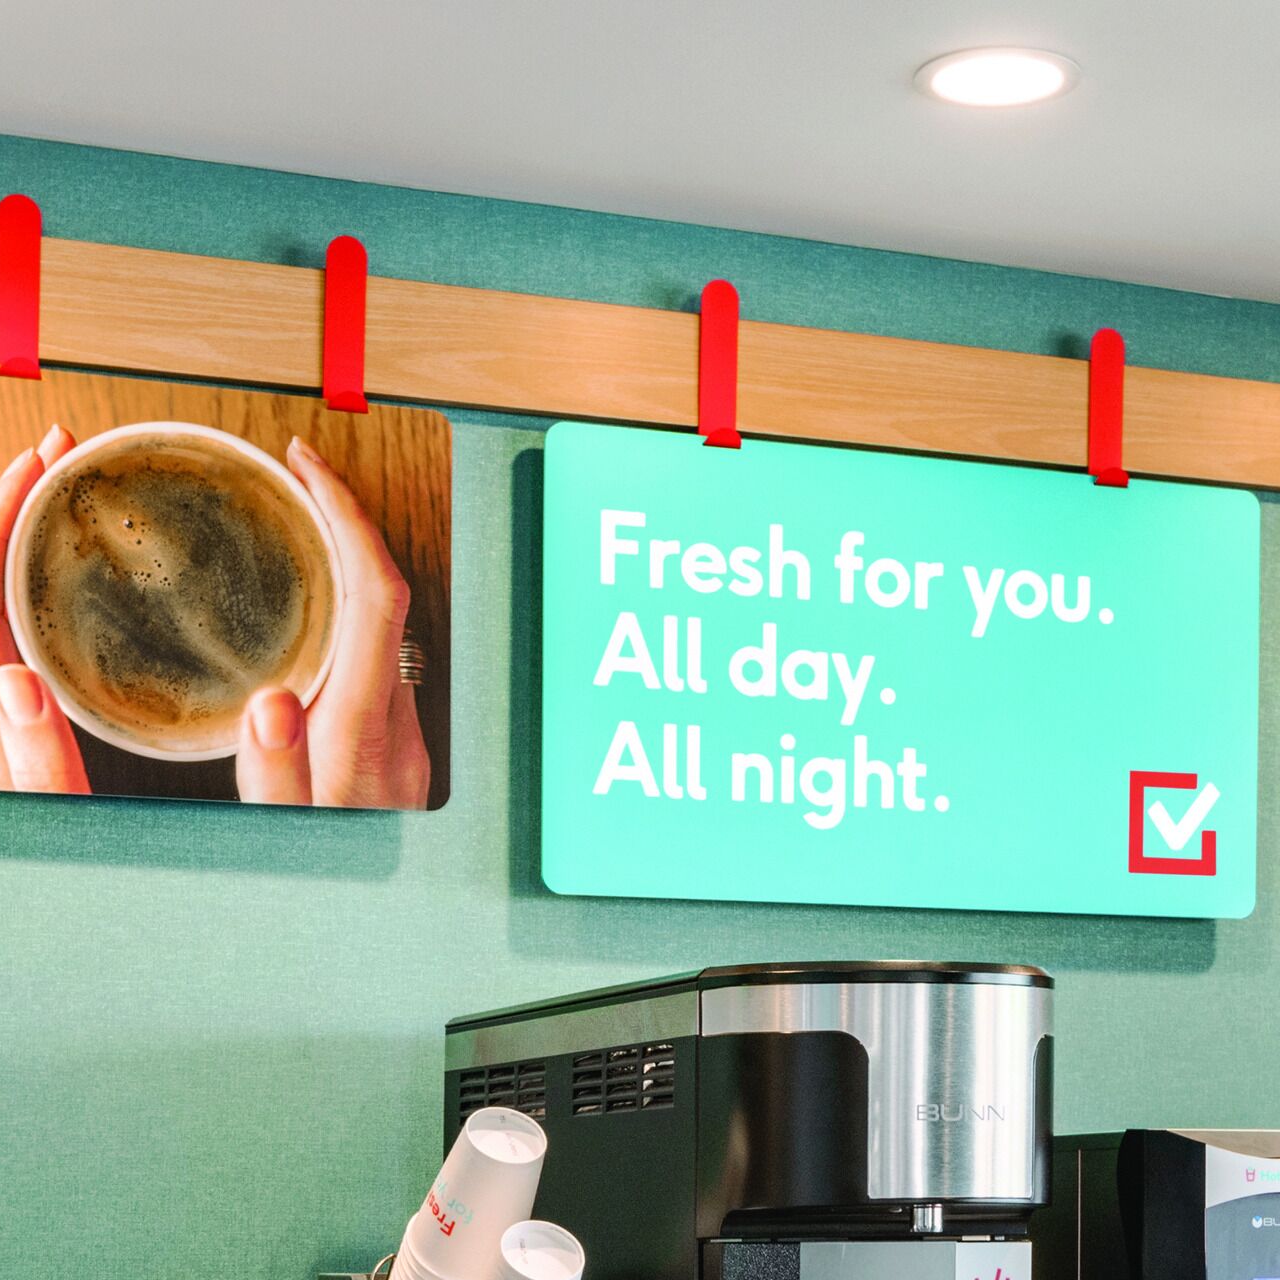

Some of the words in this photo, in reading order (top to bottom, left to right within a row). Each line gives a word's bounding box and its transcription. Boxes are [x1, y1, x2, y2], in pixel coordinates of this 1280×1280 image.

[600, 508, 811, 601] Fresh
[834, 531, 944, 610] for
[962, 566, 1115, 638] you.
[592, 611, 708, 694] All
[728, 622, 898, 726] day.
[592, 720, 707, 801] All
[730, 733, 951, 830] night.
[916, 1104, 1005, 1121] BUNN
